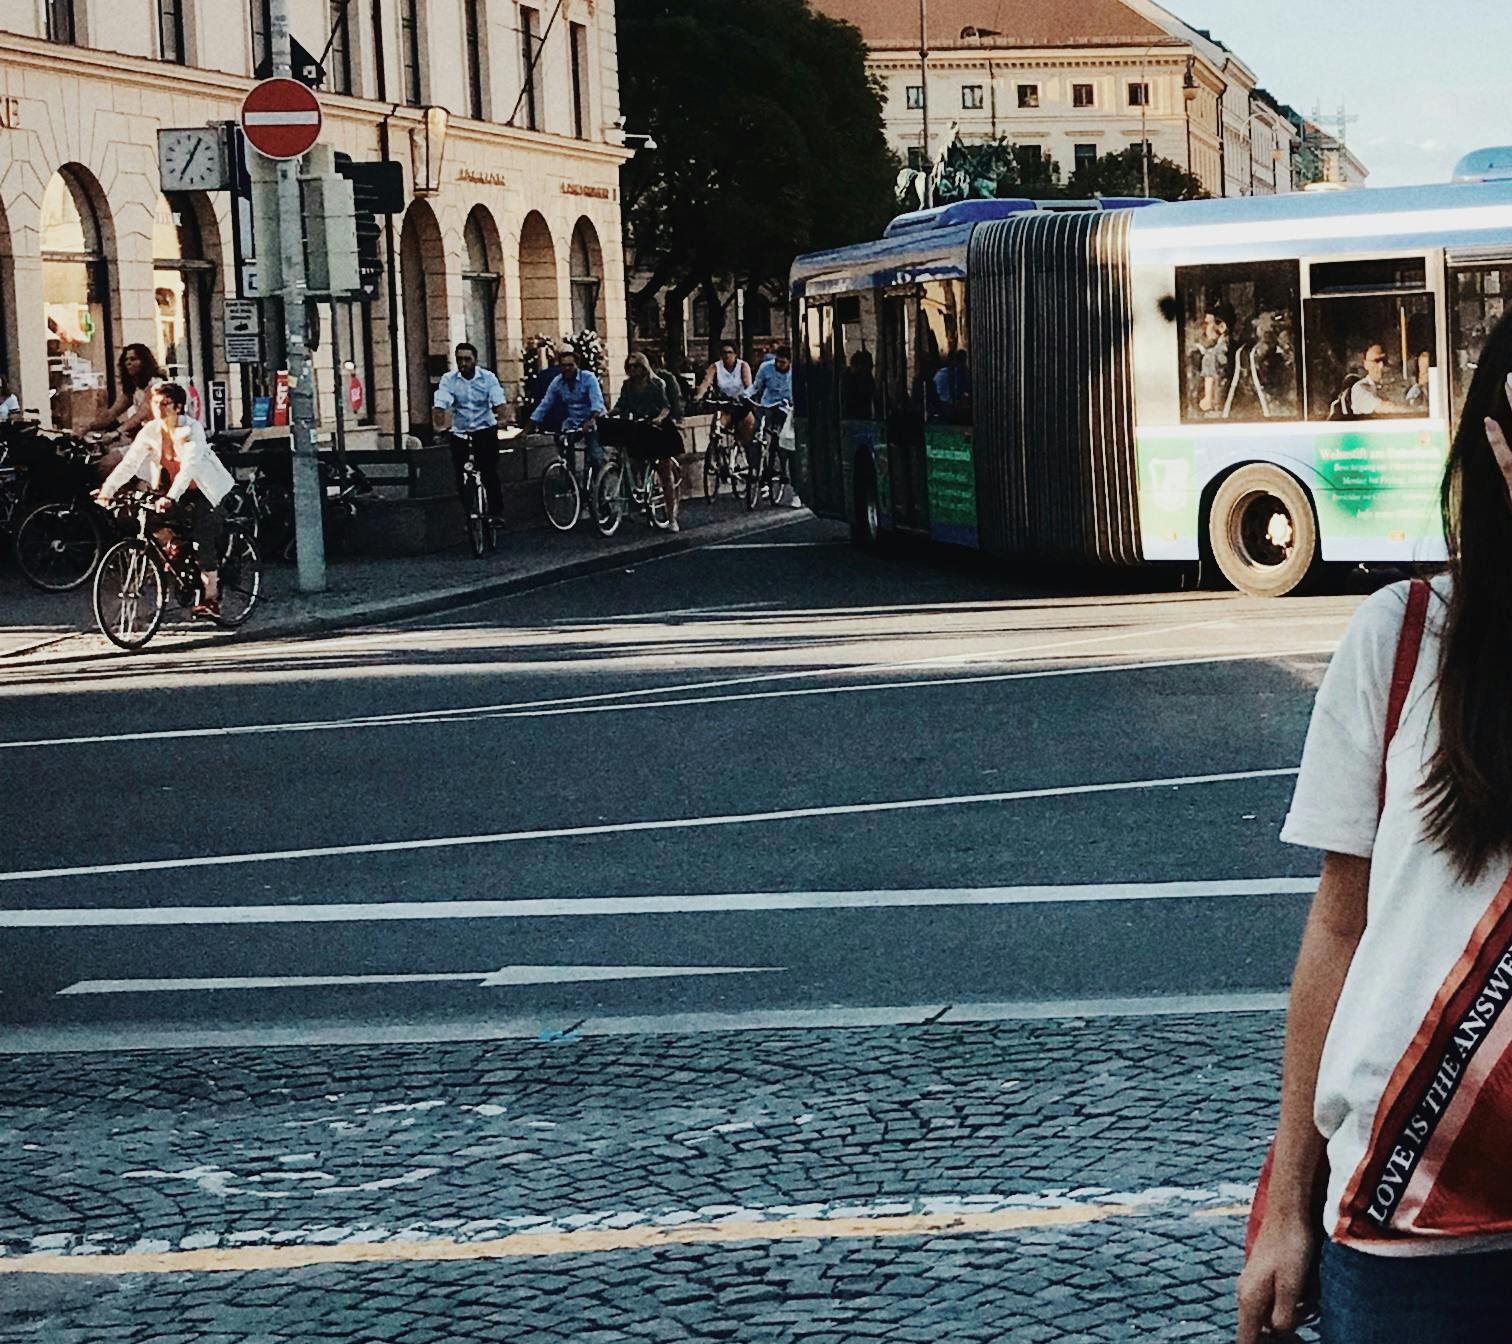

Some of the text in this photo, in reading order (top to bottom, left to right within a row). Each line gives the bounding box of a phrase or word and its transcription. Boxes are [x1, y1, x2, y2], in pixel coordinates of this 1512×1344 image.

[1367, 1145, 1415, 1223] LOVE
[1404, 1114, 1428, 1145] IS
[1422, 1054, 1460, 1115] THE
